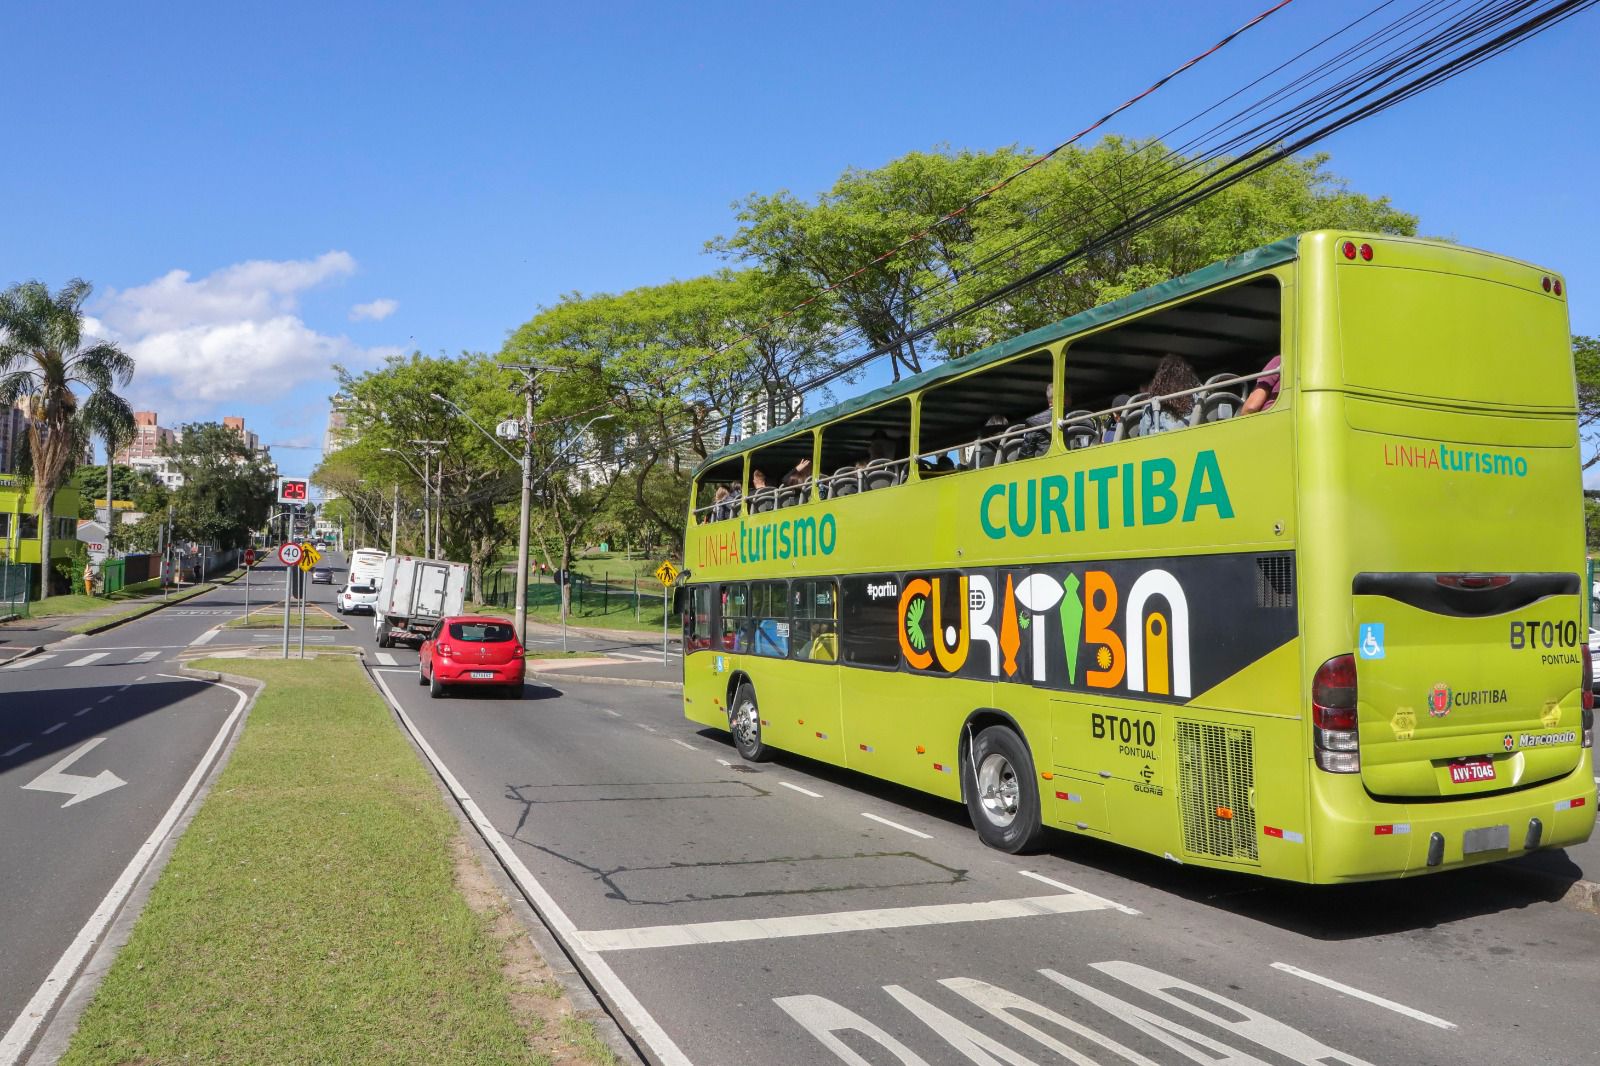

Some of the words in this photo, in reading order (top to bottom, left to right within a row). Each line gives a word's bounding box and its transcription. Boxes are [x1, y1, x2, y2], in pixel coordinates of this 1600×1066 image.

[284, 483, 304, 499] 25
[980, 449, 1235, 539] CURITIBA
[284, 548, 299, 558] 40
[867, 581, 897, 600] #partiu
[898, 569, 1192, 698] CURITIBA
[1510, 620, 1577, 650] BT010
[1541, 654, 1580, 665] PONTUAL
[1454, 689, 1508, 706] CURITIBA
[1091, 713, 1156, 747] BT010
[1519, 731, 1576, 747] Marcopolo
[1119, 745, 1157, 760] PONTUAL
[1453, 764, 1494, 780] AVV-7046
